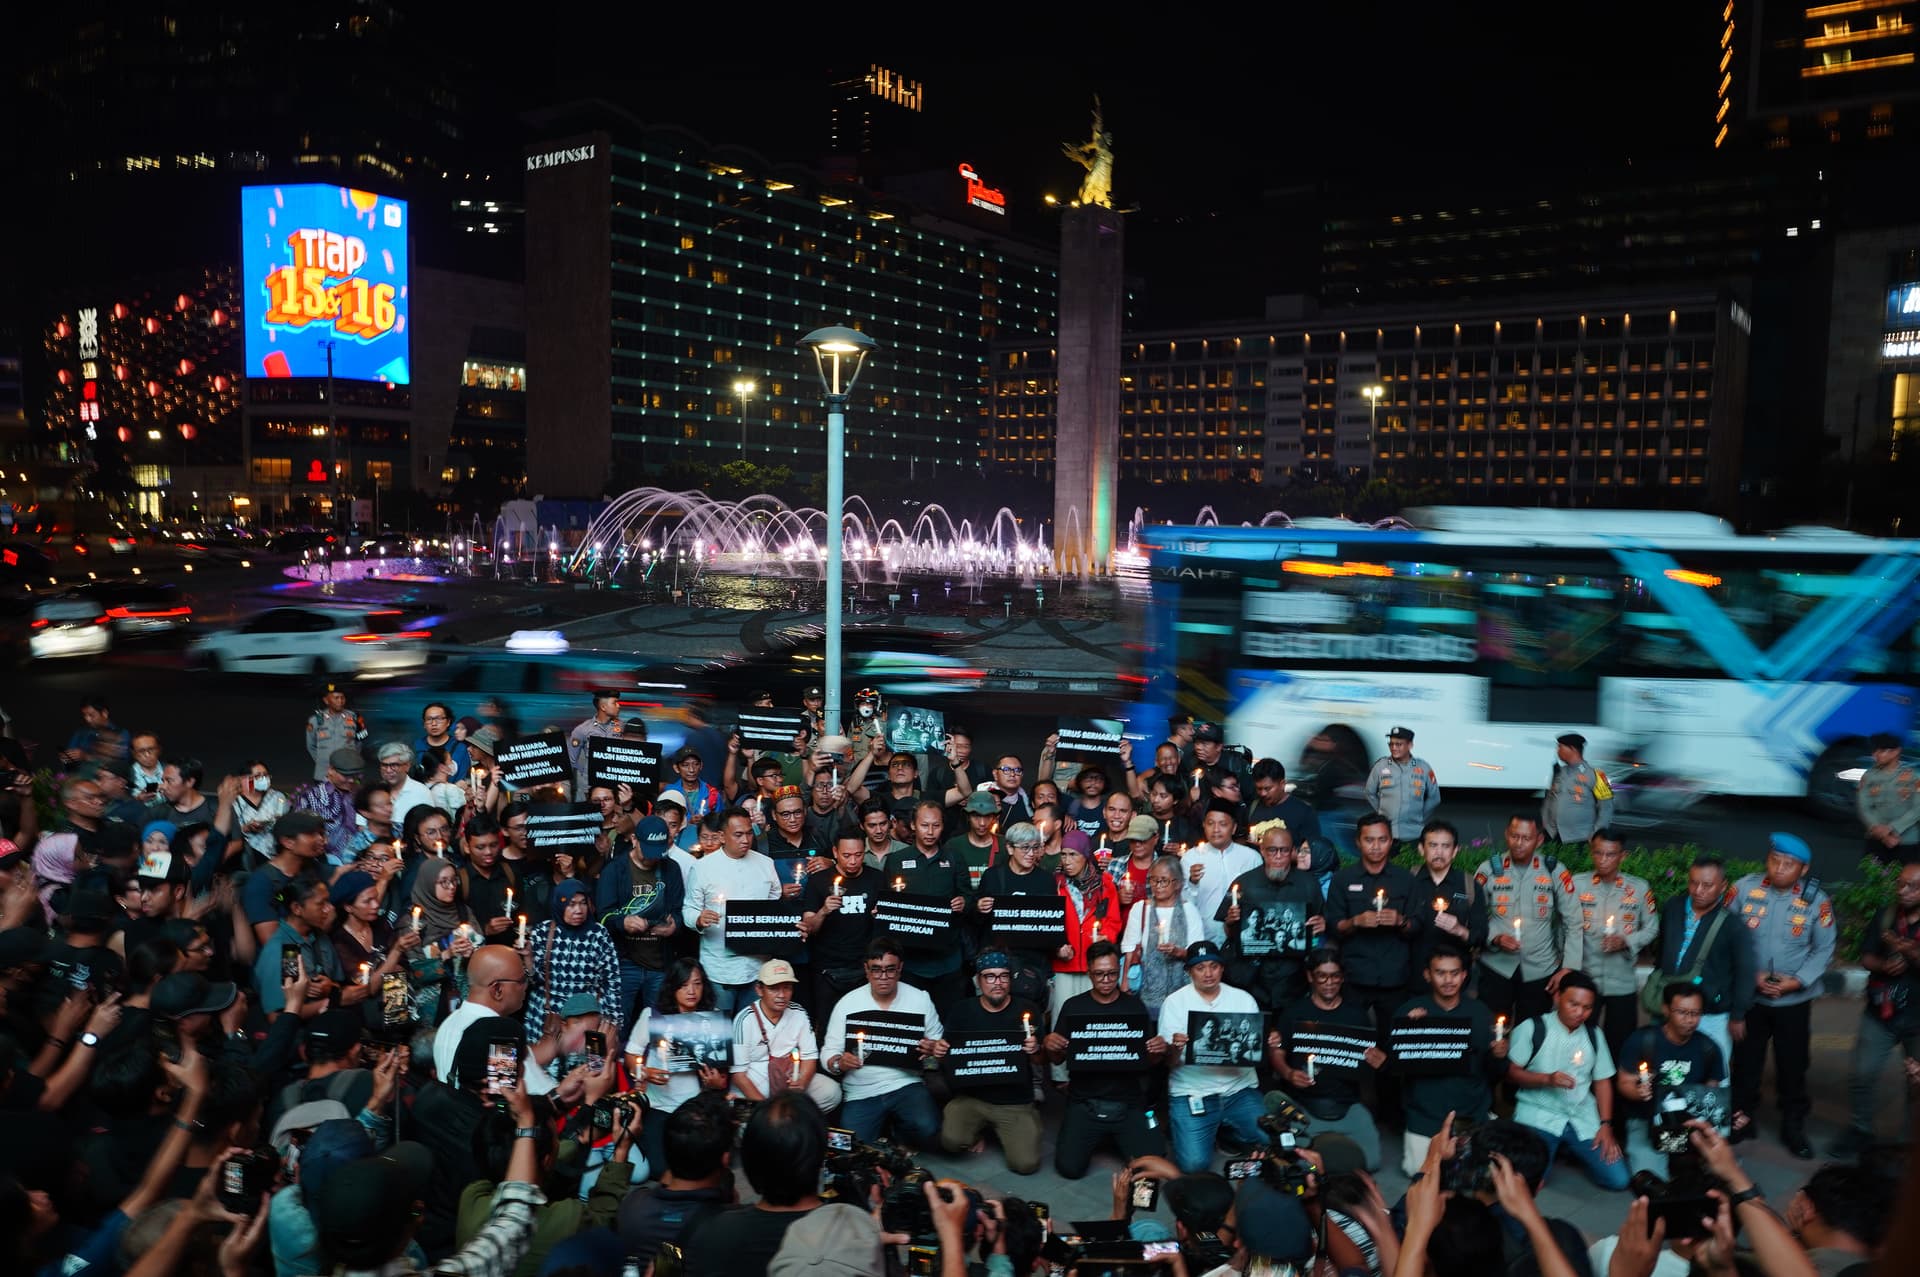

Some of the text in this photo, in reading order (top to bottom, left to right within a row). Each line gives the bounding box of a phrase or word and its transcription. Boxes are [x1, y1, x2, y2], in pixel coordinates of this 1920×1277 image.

[527, 144, 595, 170] KEMPINSKI
[281, 266, 326, 317] 15
[352, 277, 396, 330] 16
[515, 741, 548, 752] KELUARGA
[612, 747, 644, 756] KELUARGA
[498, 746, 562, 762] MASIH MENUNGGU
[593, 751, 656, 765] MASIH MENUNGGU
[521, 760, 550, 770] HARAPAN
[505, 765, 563, 781] MASIH MENYALA
[612, 767, 640, 776] HARAPAN
[596, 771, 651, 784] MASIH MENYALA
[993, 909, 1064, 918] TERUS BERHARAP
[889, 923, 934, 935] DILUPAKAN
[977, 1045, 1022, 1053] MENUNGGU
[982, 1066, 1018, 1074] MENYALA
